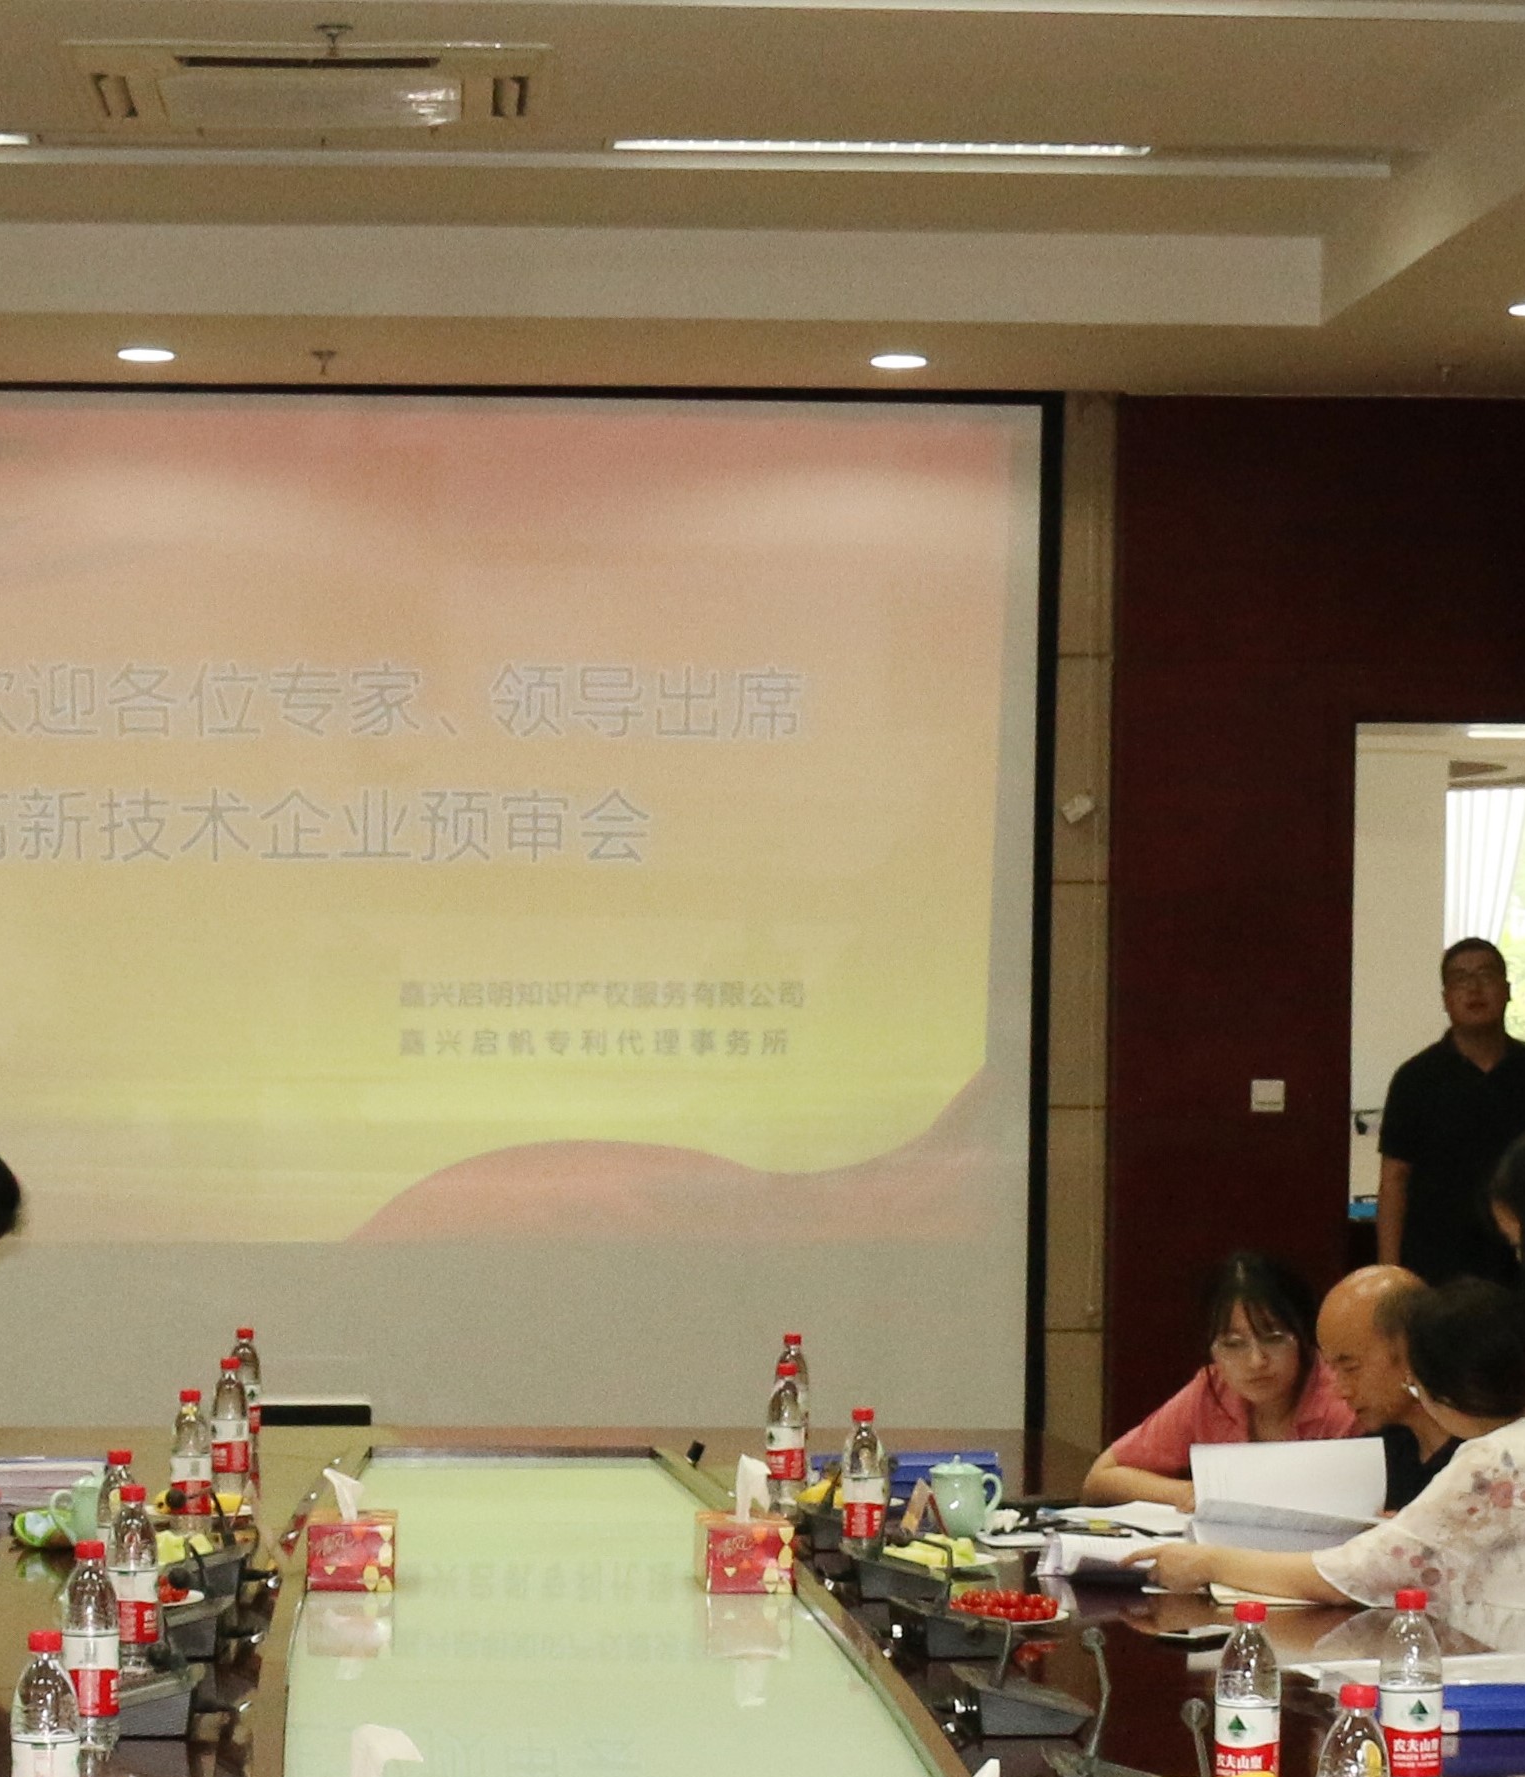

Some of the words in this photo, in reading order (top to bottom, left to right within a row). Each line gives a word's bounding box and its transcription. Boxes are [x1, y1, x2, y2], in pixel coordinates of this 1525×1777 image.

[398, 980, 805, 1010] 嘉兴启明知识产权服务有限公司
